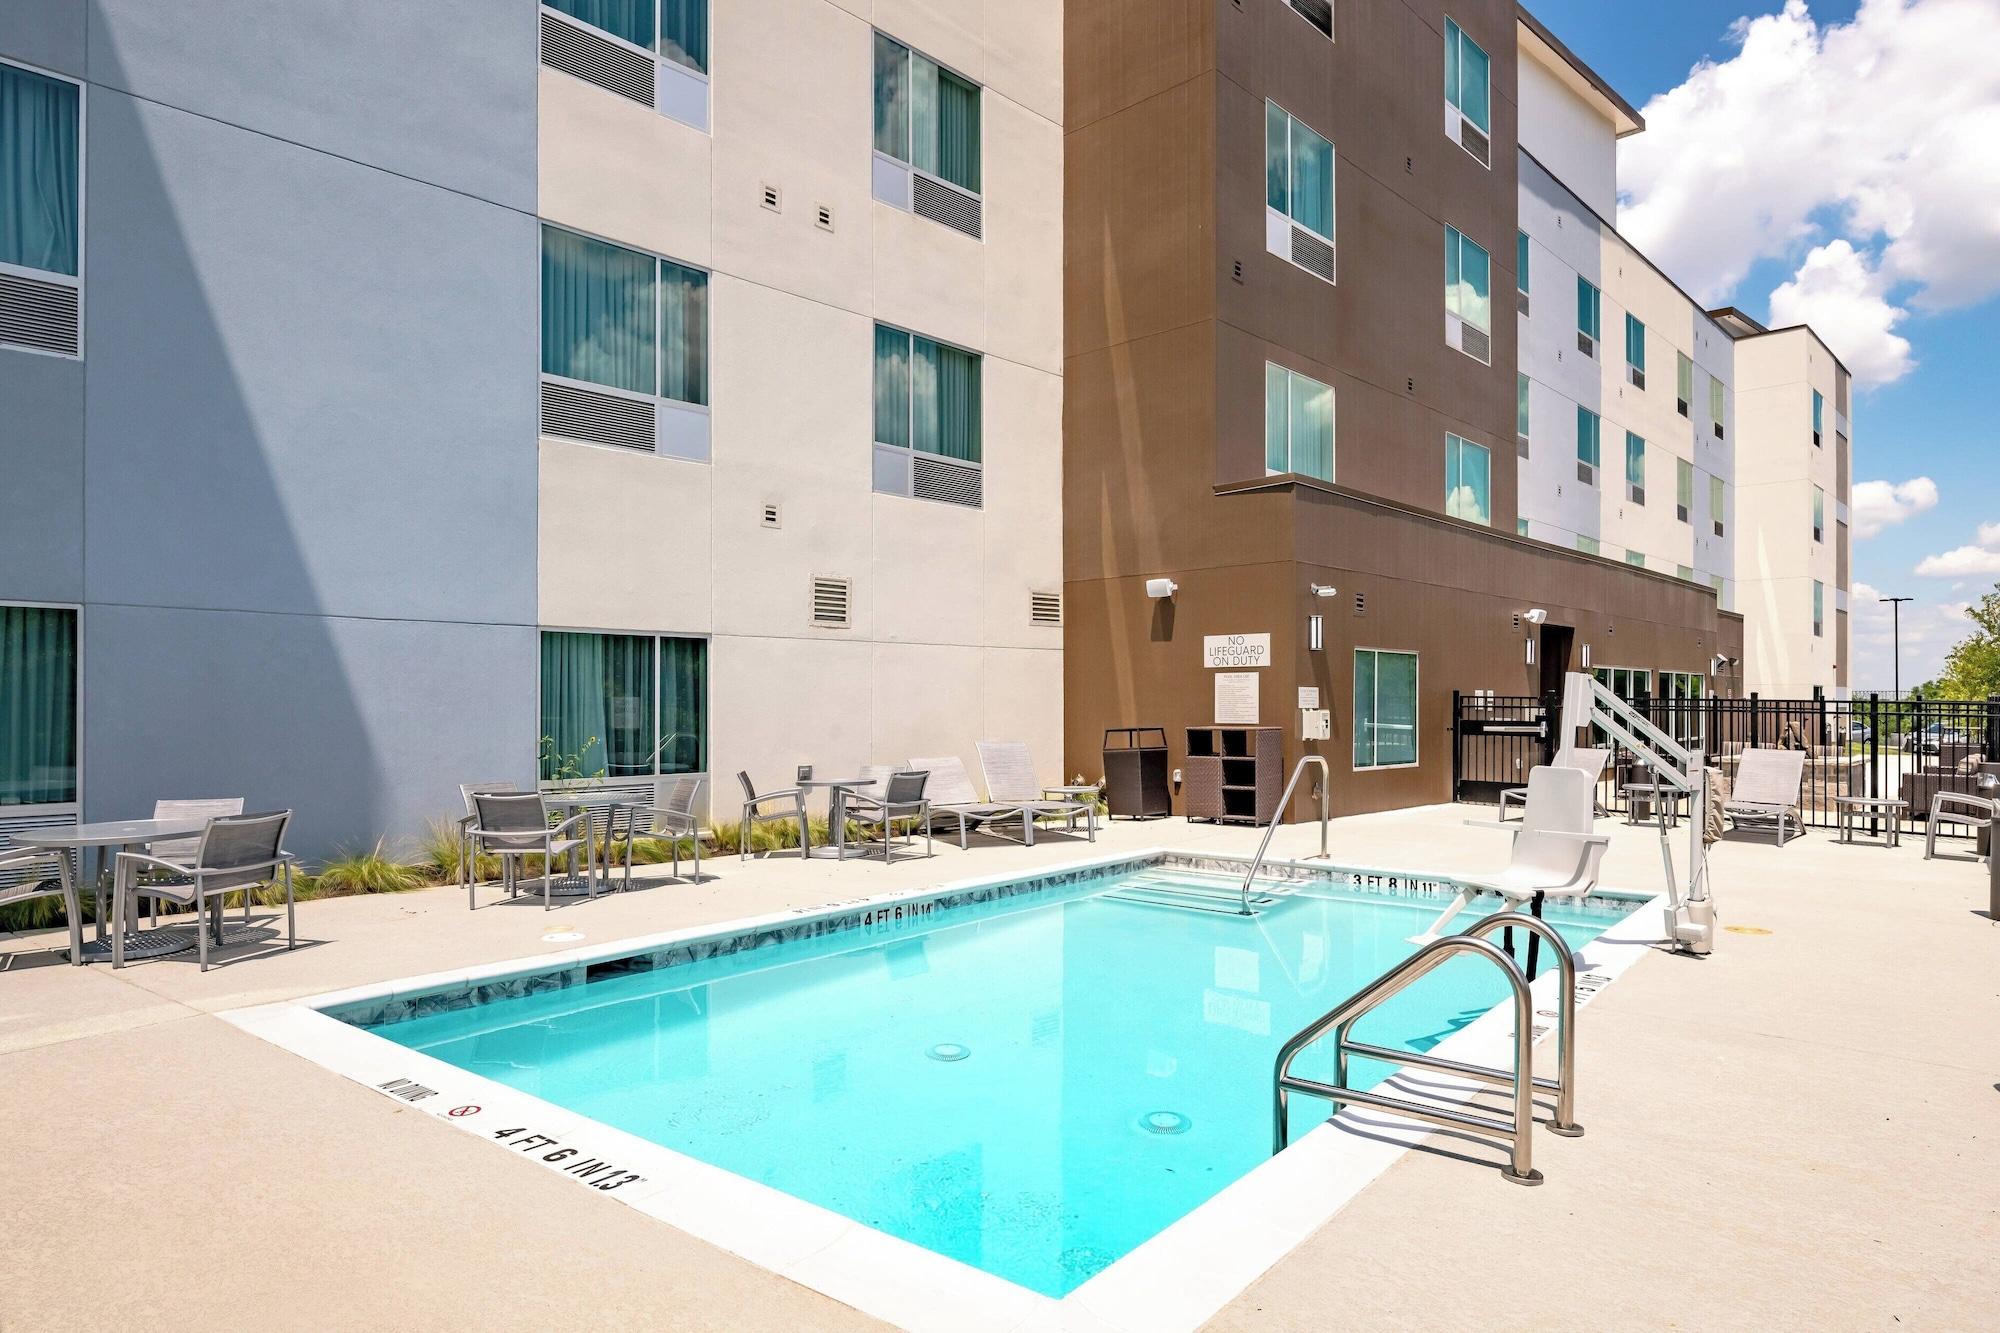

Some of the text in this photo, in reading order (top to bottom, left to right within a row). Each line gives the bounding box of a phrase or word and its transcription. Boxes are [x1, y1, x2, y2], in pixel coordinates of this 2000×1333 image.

[1228, 636, 1245, 646] NO
[1209, 645, 1264, 657] LIFEGUARD
[1213, 655, 1260, 666] ON DUTY
[1353, 874, 1362, 885] 3
[1367, 875, 1383, 887] FT
[1404, 878, 1418, 891] IN
[864, 911, 873, 926] 4
[877, 908, 890, 924] FT
[895, 906, 903, 920] 6
[907, 902, 919, 917] IN
[493, 1127, 527, 1139] 4
[508, 1134, 559, 1152] FT
[542, 1147, 579, 1163] 6
[563, 1158, 612, 1178] IN
